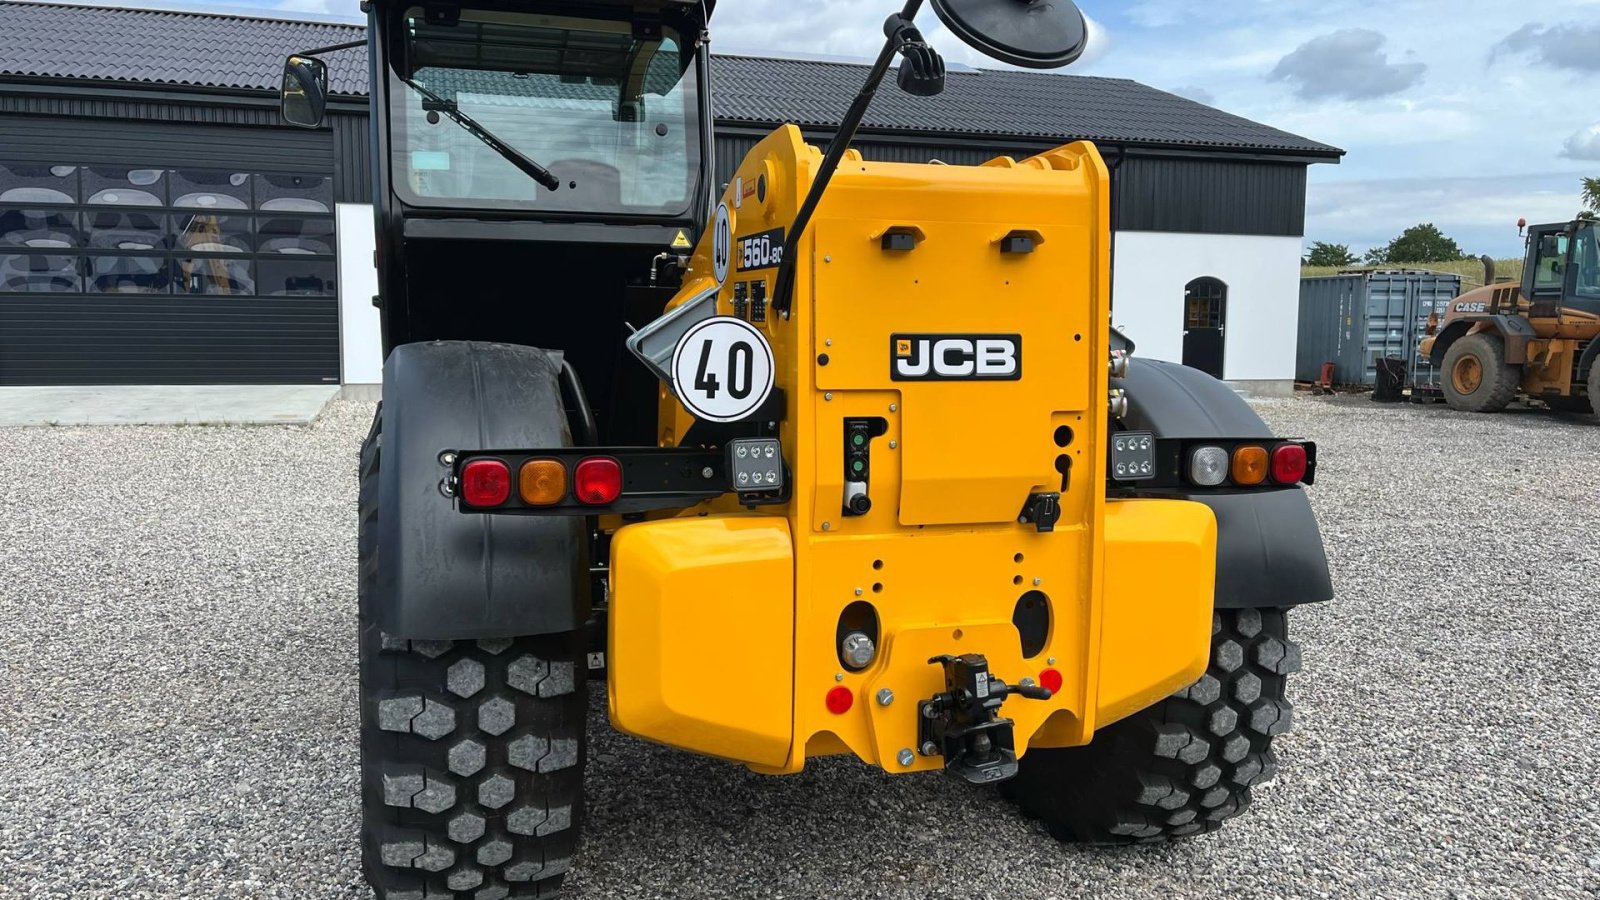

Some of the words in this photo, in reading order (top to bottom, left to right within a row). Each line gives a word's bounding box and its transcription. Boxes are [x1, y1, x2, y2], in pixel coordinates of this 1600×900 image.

[716, 218, 727, 269] 40
[1455, 302, 1486, 312] CASE
[694, 339, 754, 400] 40
[897, 339, 1017, 376] JCB
